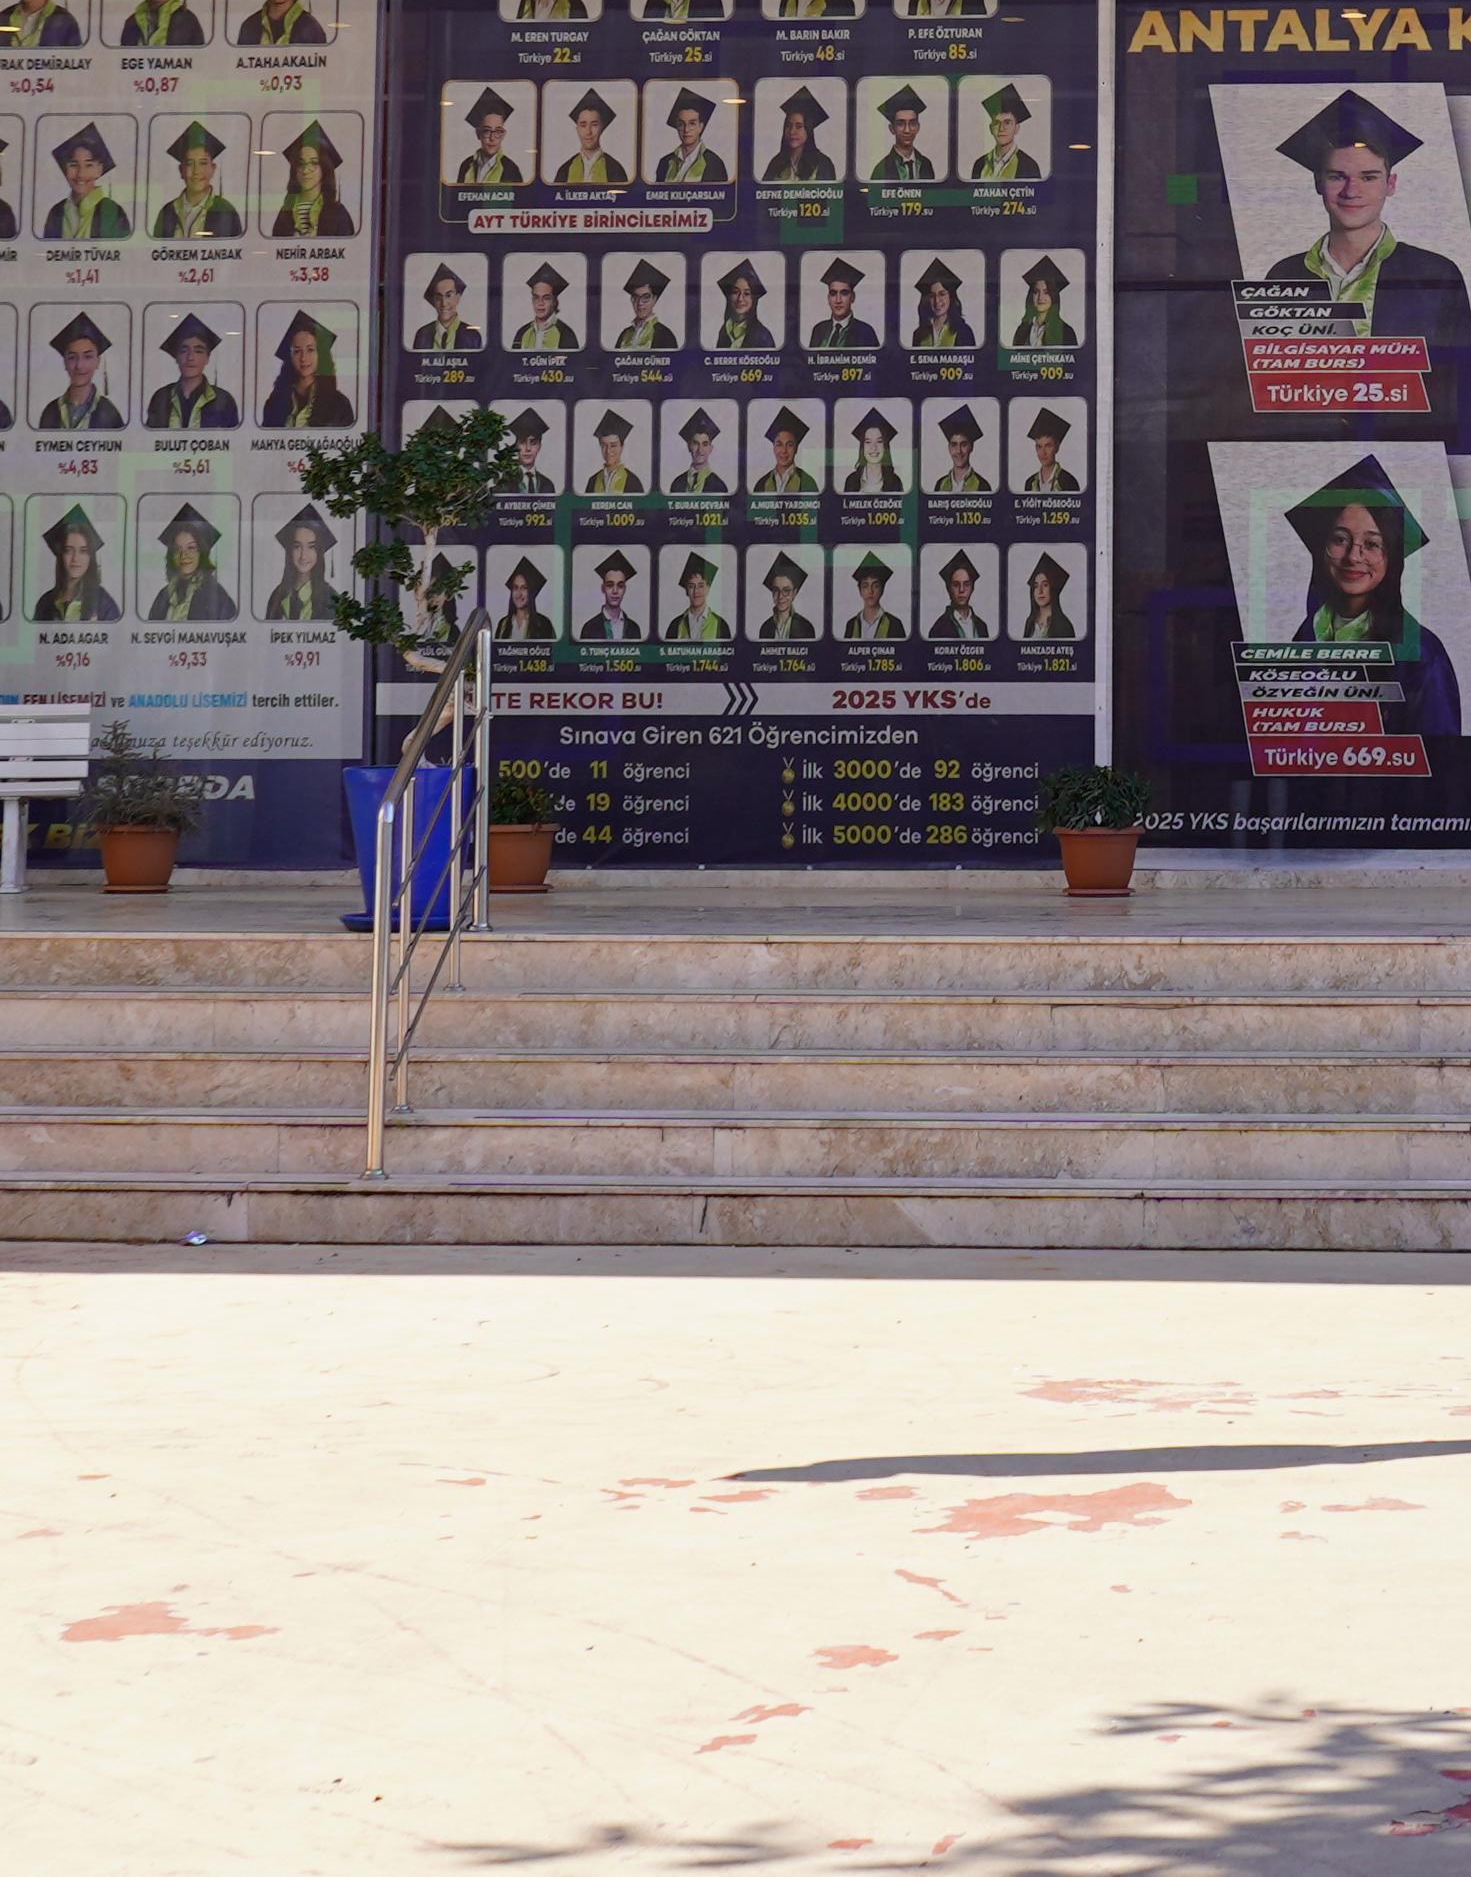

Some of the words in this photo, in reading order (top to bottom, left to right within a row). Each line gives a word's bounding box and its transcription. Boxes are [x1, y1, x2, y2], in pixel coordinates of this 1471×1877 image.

[641, 29, 678, 45] ÇAĞAN
[678, 28, 721, 42] GÖKTAN
[1128, 8, 1433, 54] ANTALYA
[121, 58, 145, 70] EGE
[147, 57, 194, 70] YAMAN
[648, 51, 683, 65] Türkiye
[683, 46, 713, 64] 25.si
[473, 214, 505, 229] AYT
[511, 210, 578, 229] TÜRKİYE
[583, 209, 708, 229] BİRİNCİLERİMİZ
[151, 246, 198, 262] GÖRKEM
[1240, 284, 1310, 300] ÇAĞAN
[1248, 305, 1332, 318] GÖKTAN
[1251, 324, 1294, 337] KOÇ
[1298, 323, 1337, 336] ÜNİ.
[1251, 342, 1367, 356] BİLGİSAYAR
[1369, 342, 1421, 355] MÜH.
[1251, 358, 1301, 370] (TAM
[1304, 358, 1366, 370] BURS)
[1266, 384, 1349, 406] Türkiye
[1352, 382, 1409, 403] 25.si
[154, 439, 188, 452] BULUT
[190, 439, 230, 455] ÇOBAN
[144, 628, 176, 643] SEVGİ
[269, 628, 295, 643] İPEK
[296, 631, 337, 643] YILMAZ
[1240, 646, 1314, 660] CEMİLE
[1316, 648, 1382, 660] BERRE
[1248, 668, 1358, 682] KÖSEOĞLU
[110, 697, 126, 708] ve
[128, 694, 188, 708] ANADOLU
[191, 691, 248, 708] LİSEMİZİ
[252, 693, 290, 708] tercih
[294, 693, 340, 708] ettiler.
[529, 691, 616, 710] REKOR
[622, 691, 664, 710] BU!
[832, 689, 897, 710] 2025
[903, 689, 992, 710] YKS'de
[1251, 685, 1339, 699] ÖZYEĞİN
[1343, 685, 1384, 699] ÜNİ.
[1251, 707, 1325, 718] HUKUK
[559, 725, 637, 746] Sınava
[642, 725, 703, 745] Giren
[708, 726, 742, 745] 621
[748, 720, 920, 749] Öğrencimizden
[1251, 721, 1301, 733] (TAM
[1303, 721, 1366, 733] BURS)
[173, 730, 238, 752] teşekkür
[242, 730, 314, 753] ediyoruz.
[1264, 747, 1339, 770] Türkiye
[1341, 745, 1416, 767] 669.su
[498, 759, 571, 780] 500'de
[589, 760, 609, 779] 11
[622, 761, 691, 783] öğrenci
[833, 759, 922, 780] 3000'de
[933, 760, 961, 779] 92
[970, 760, 1040, 783] öğrenci
[586, 793, 611, 812] 19
[622, 793, 690, 814] öğrenci
[831, 792, 922, 812] 4000'de
[928, 792, 965, 812] 183
[970, 793, 1039, 815] öğrenci
[1188, 812, 1229, 831] YKS
[1232, 812, 1385, 835] başarılarımızın
[581, 825, 613, 844] 44
[622, 826, 690, 847] öğrenci
[832, 824, 922, 845] 5000'de
[926, 825, 968, 845] 286
[971, 827, 1039, 848] öğrenci
